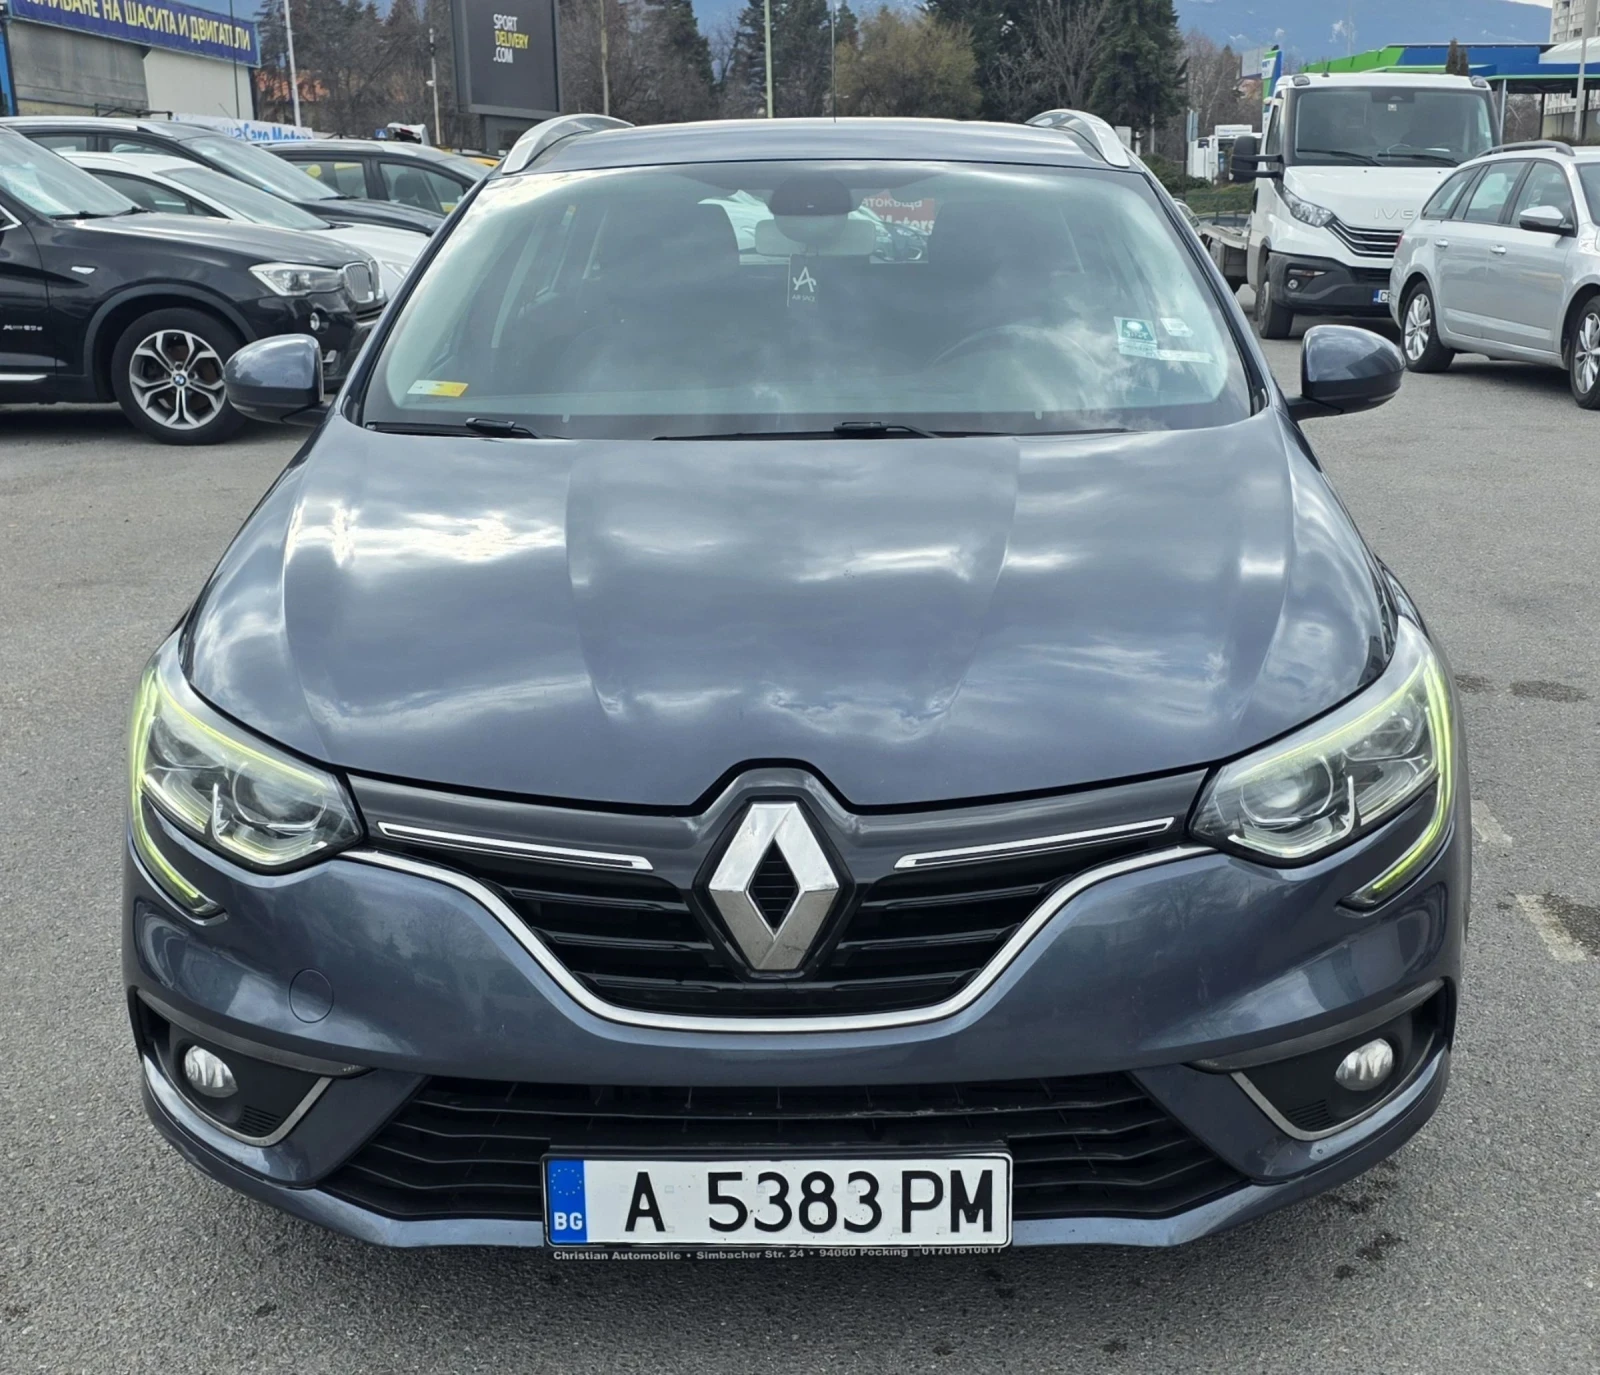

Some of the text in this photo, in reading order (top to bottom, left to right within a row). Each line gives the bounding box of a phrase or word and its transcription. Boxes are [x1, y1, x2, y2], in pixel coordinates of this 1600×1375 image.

[102, 0, 122, 23] НА
[124, 1, 178, 35] ШАСИТА
[178, 13, 189, 37] И
[493, 14, 518, 31] SPORT
[495, 31, 529, 49] DELIVERY
[493, 47, 514, 63] .COM
[1374, 208, 1414, 220] IVE
[625, 1170, 993, 1233] A 5383 PM
[554, 1212, 583, 1230] BG
[553, 1251, 609, 1261] Christian
[612, 1251, 681, 1261] Automobile
[696, 1250, 761, 1260] Simbacher
[765, 1249, 786, 1260] Str.
[789, 1249, 804, 1258] 24
[819, 1248, 856, 1258] 94060
[860, 1248, 908, 1258] Pocking
